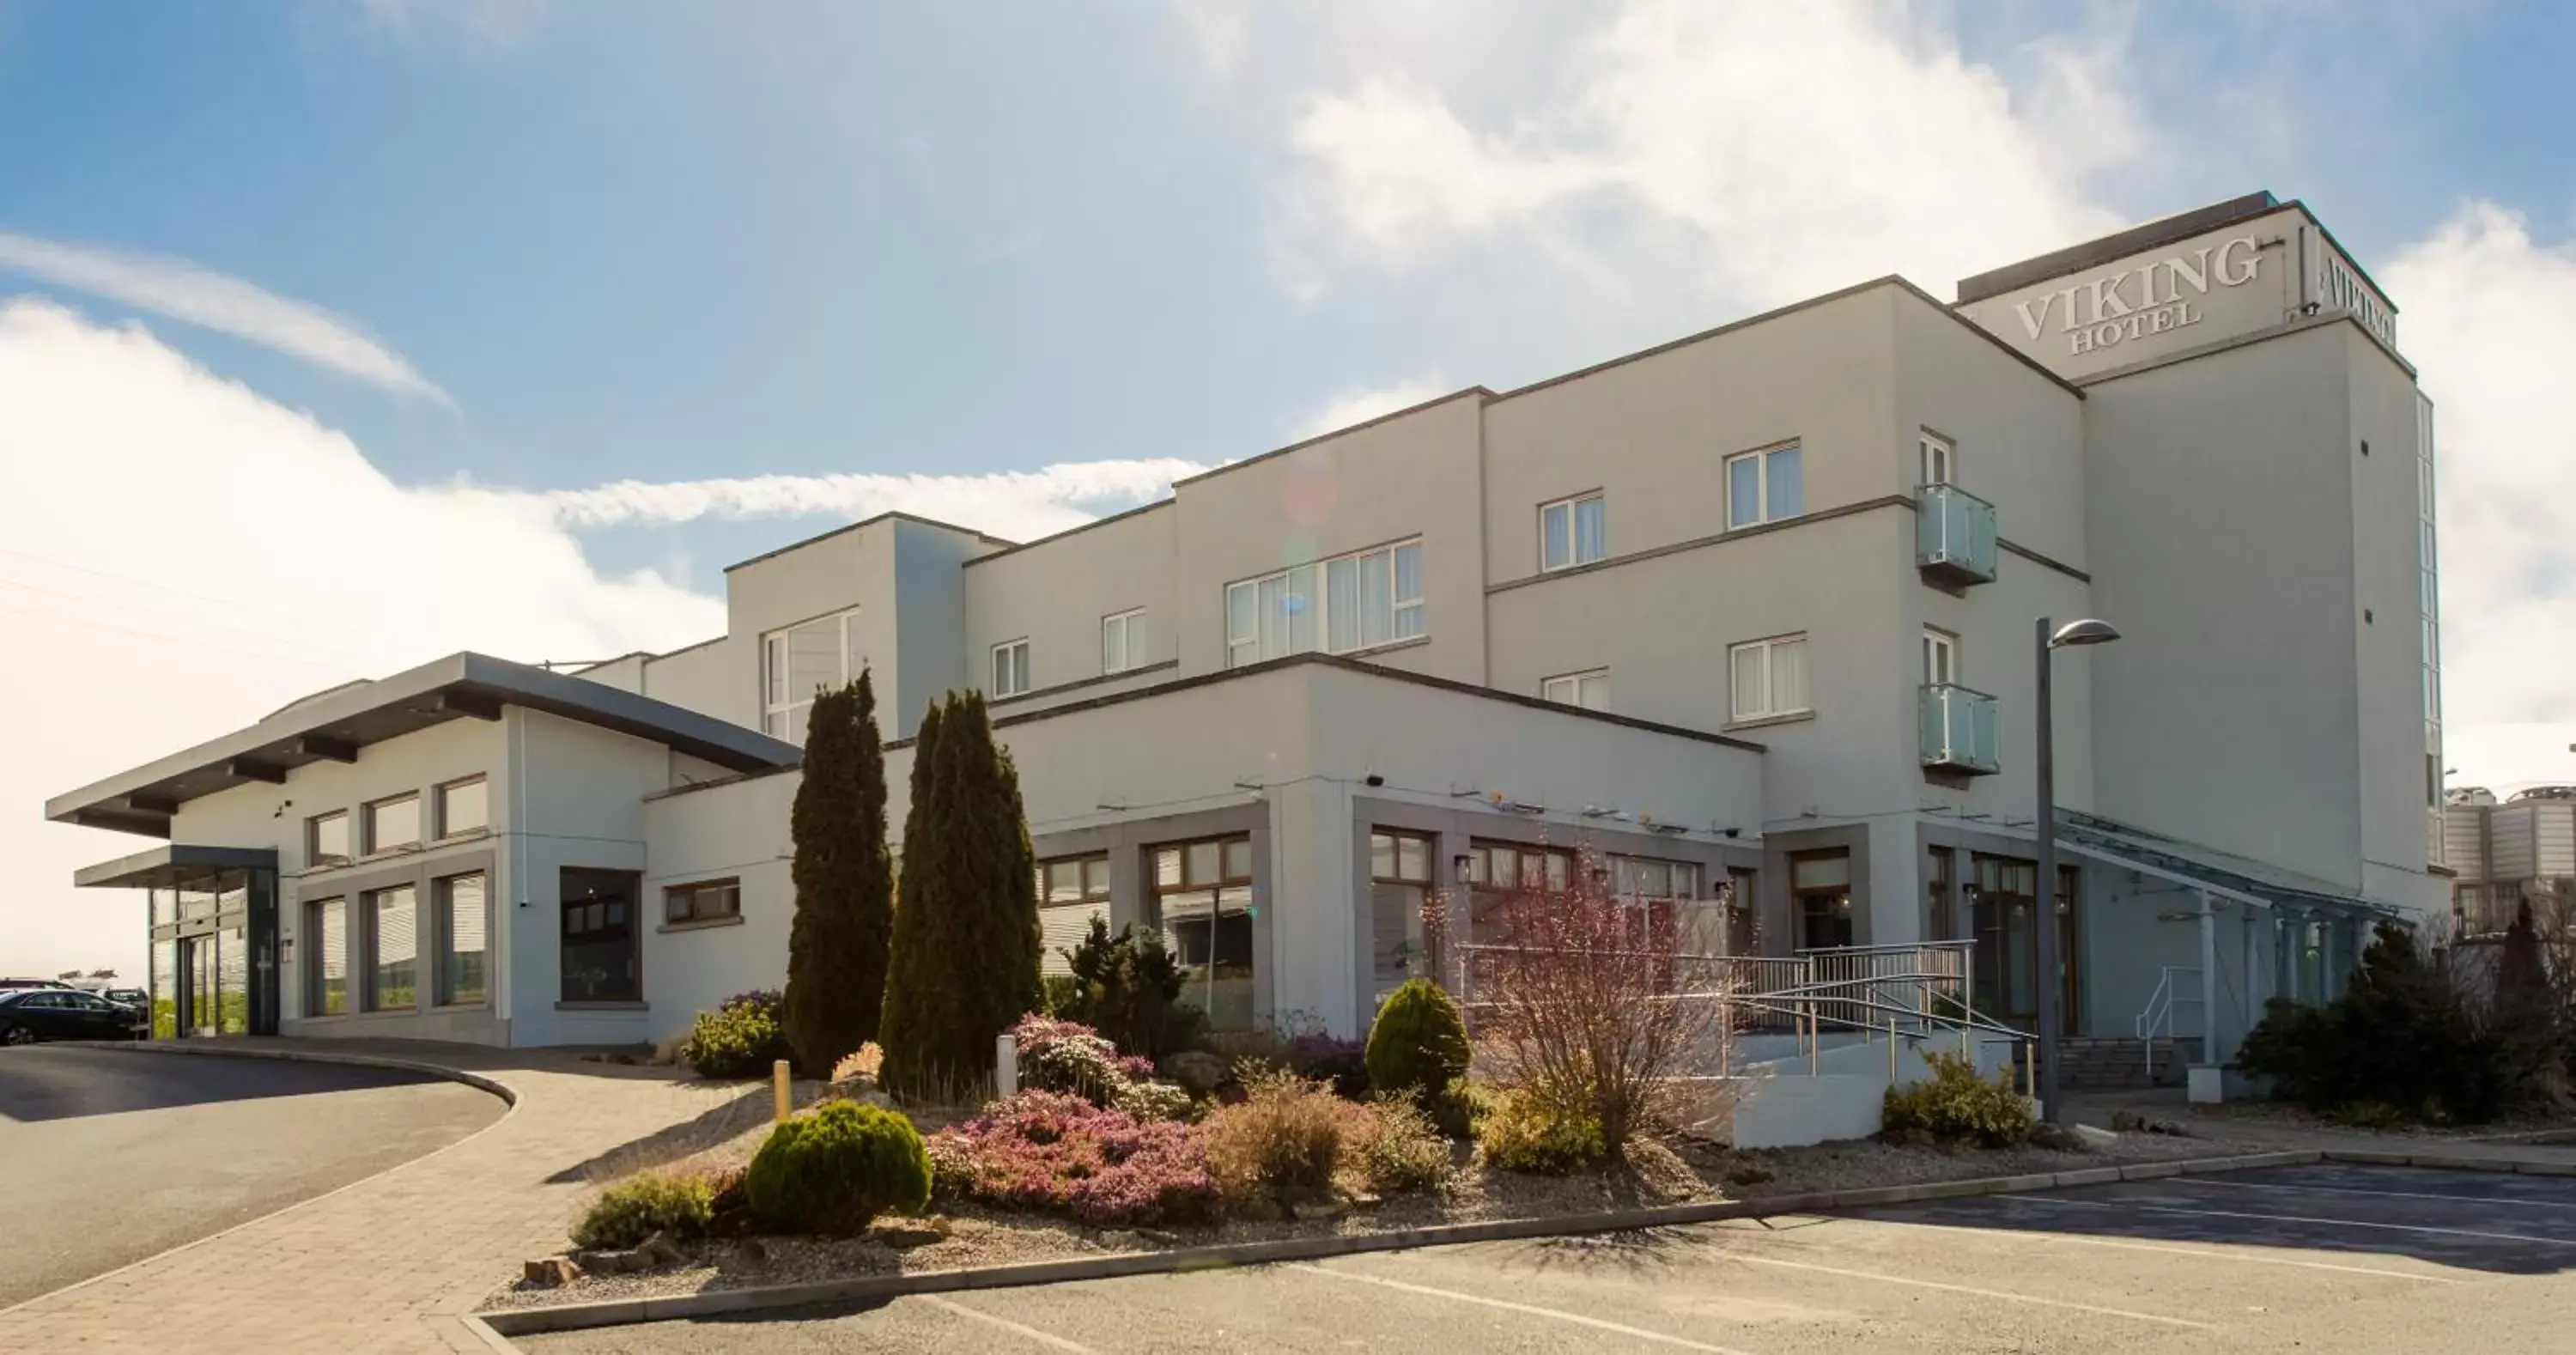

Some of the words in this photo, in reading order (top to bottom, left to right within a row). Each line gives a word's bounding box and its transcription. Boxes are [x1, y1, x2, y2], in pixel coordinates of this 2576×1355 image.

[2014, 234, 2263, 341] VIKING
[2071, 301, 2203, 355] HOTEL
[2328, 256, 2392, 343] VIKING
